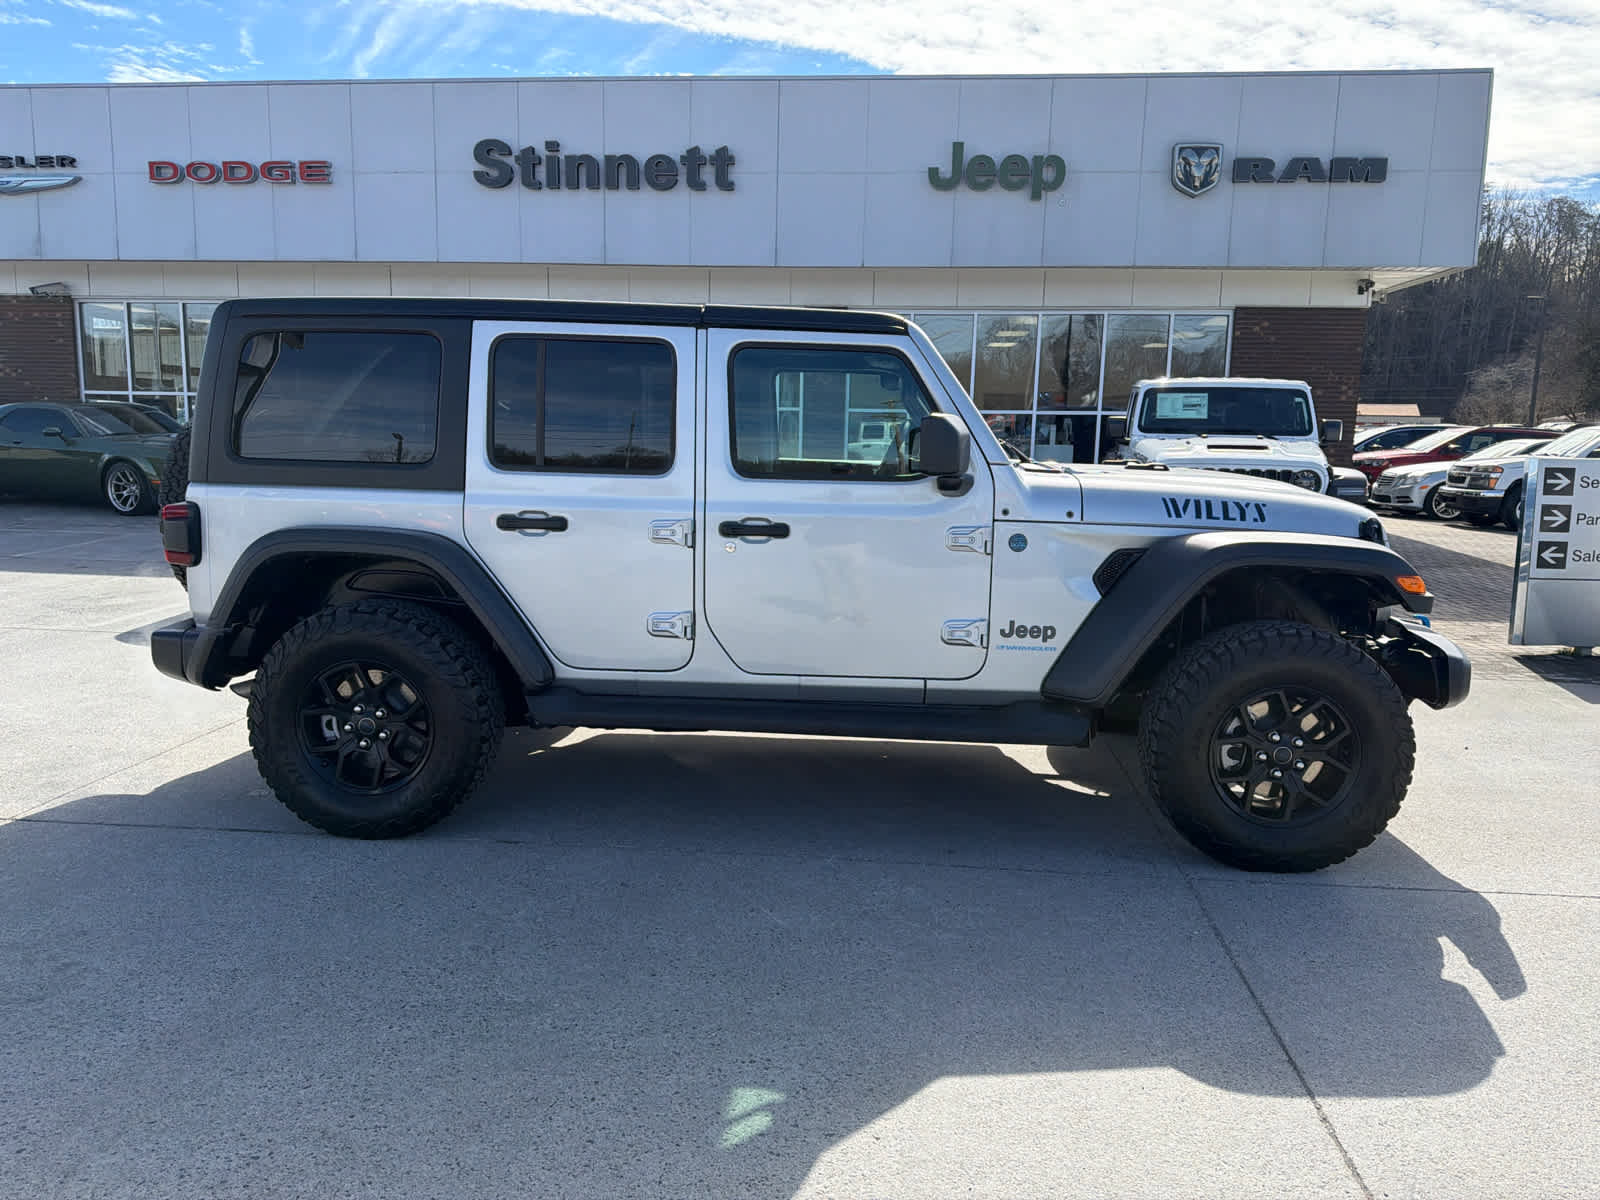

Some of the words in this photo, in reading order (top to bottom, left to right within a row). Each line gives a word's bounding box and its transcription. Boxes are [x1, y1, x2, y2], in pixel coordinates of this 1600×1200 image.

[148, 160, 332, 185] DODGE
[473, 138, 736, 192] Stinnett
[928, 141, 1067, 201] Jeep
[1232, 156, 1388, 184] RAM
[1161, 496, 1267, 523] WILLYS
[999, 619, 1057, 643] Jeep
